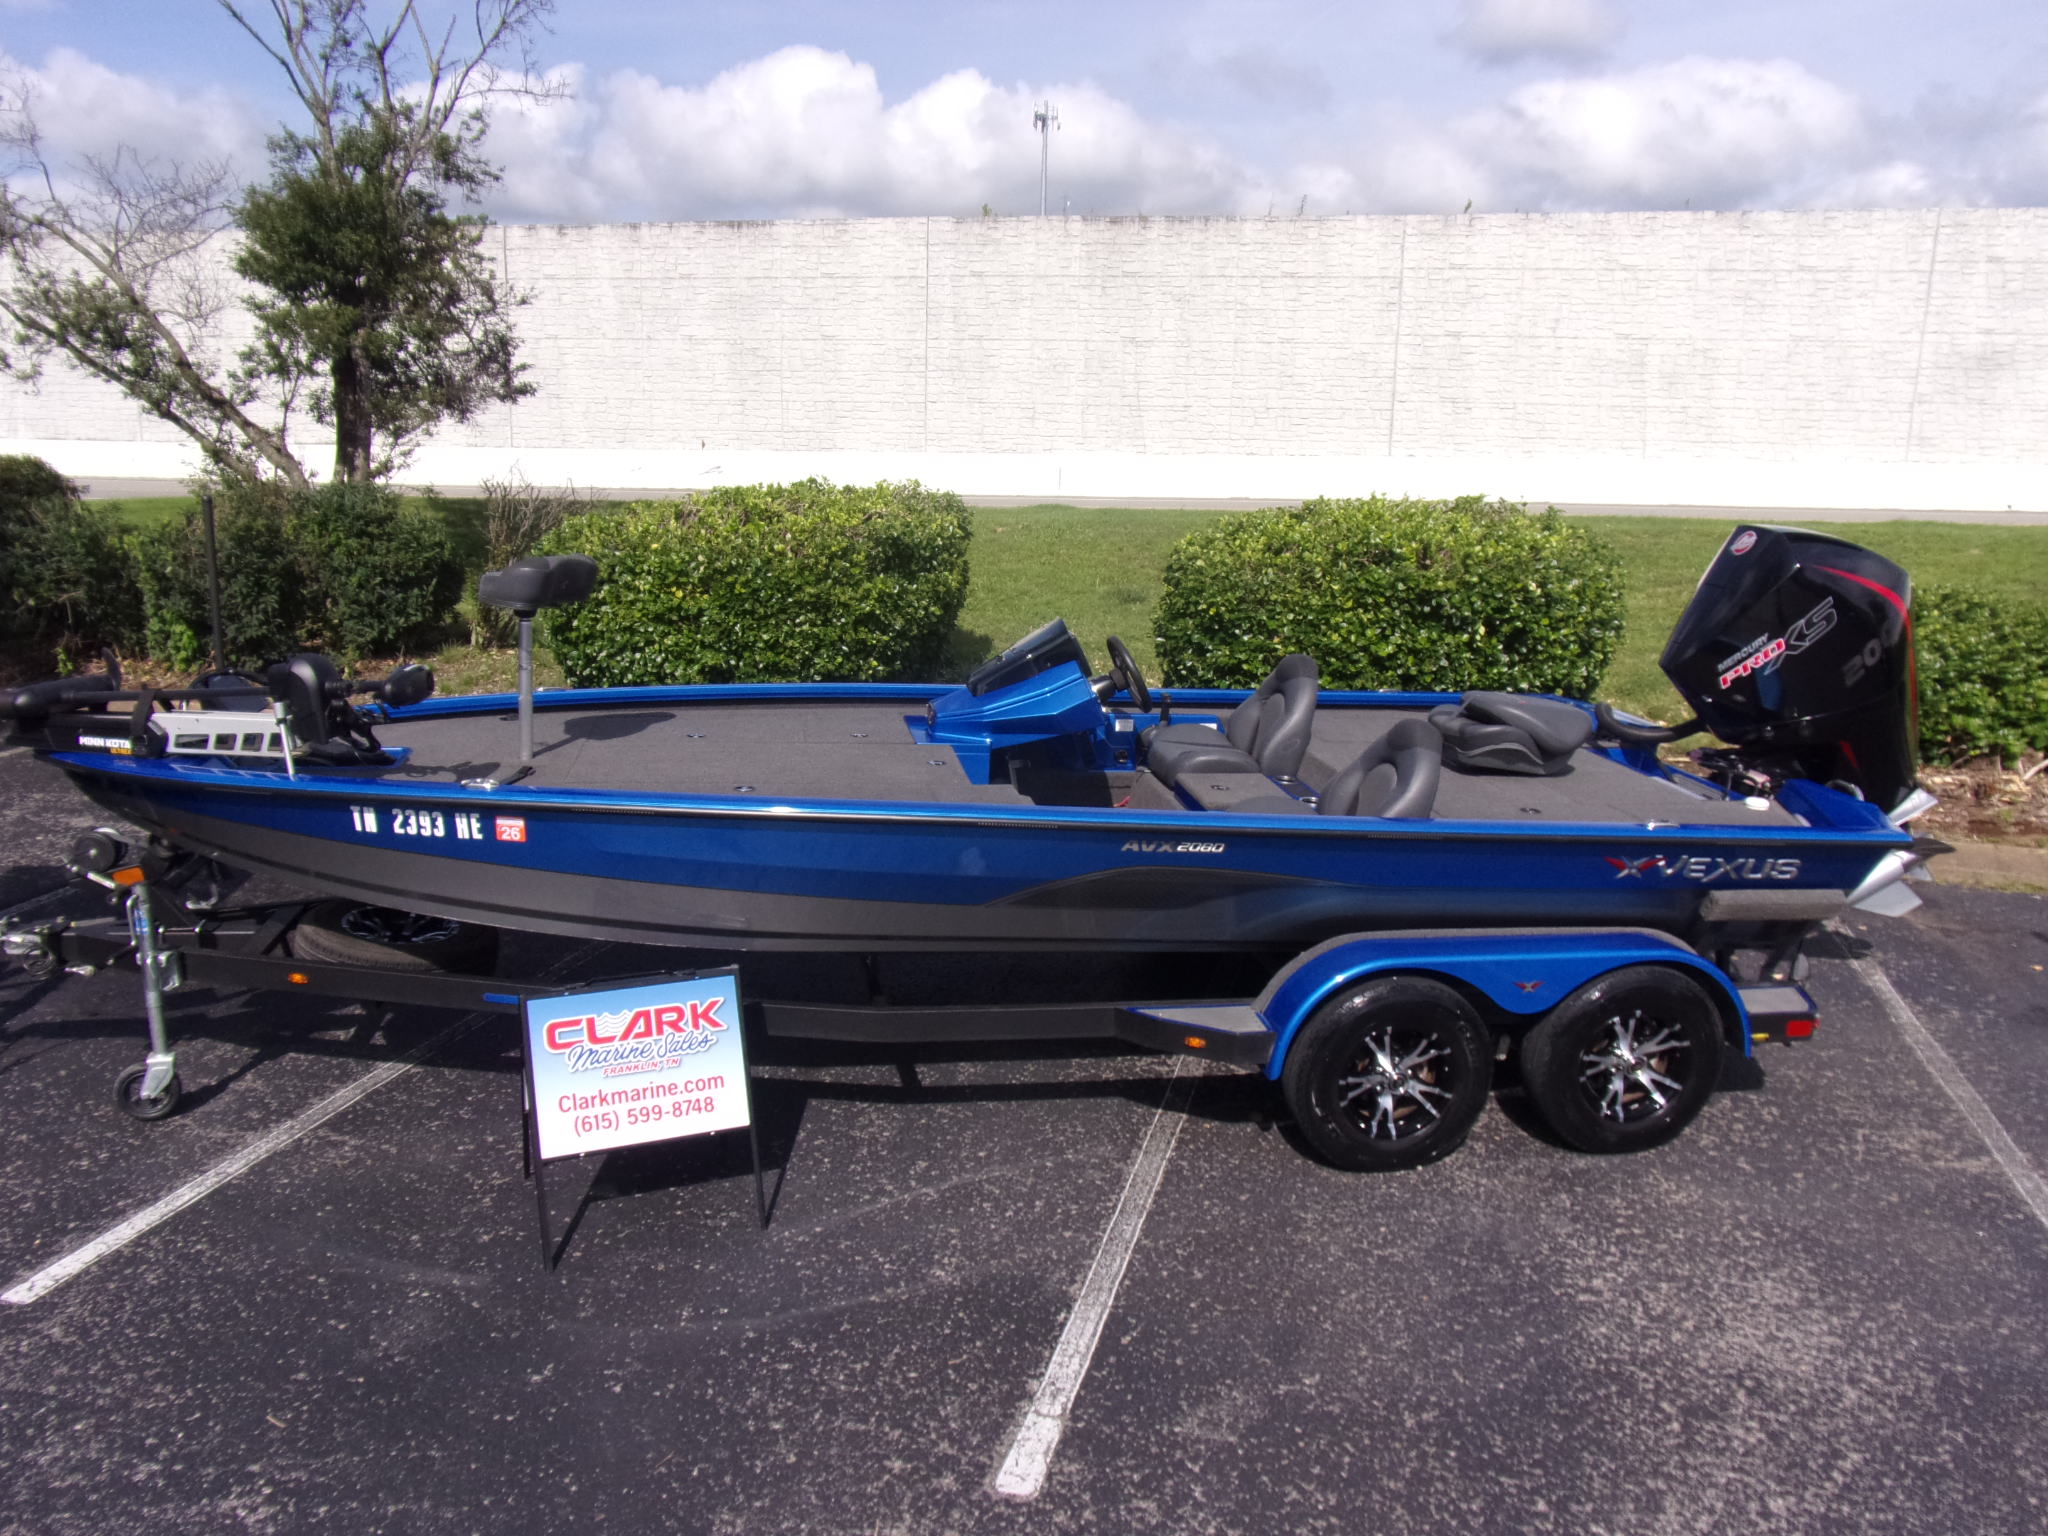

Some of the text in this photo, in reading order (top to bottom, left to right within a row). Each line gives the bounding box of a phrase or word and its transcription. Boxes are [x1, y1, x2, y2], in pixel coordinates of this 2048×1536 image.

[1718, 632, 1769, 672] MERCURY
[1720, 638, 1786, 689] PRO
[79, 735, 132, 750] MINN KOTA
[350, 805, 484, 840] TN 2393 HE
[501, 826, 521, 841] 26
[1655, 854, 1802, 883] VEXUS
[544, 998, 726, 1051] CLARK
[568, 1030, 715, 1071] Marine Sales
[602, 1057, 680, 1076] FRANKLIN, TN
[558, 1075, 725, 1113] Clarkmarine.com
[574, 1096, 715, 1137] (615) 599-8748
